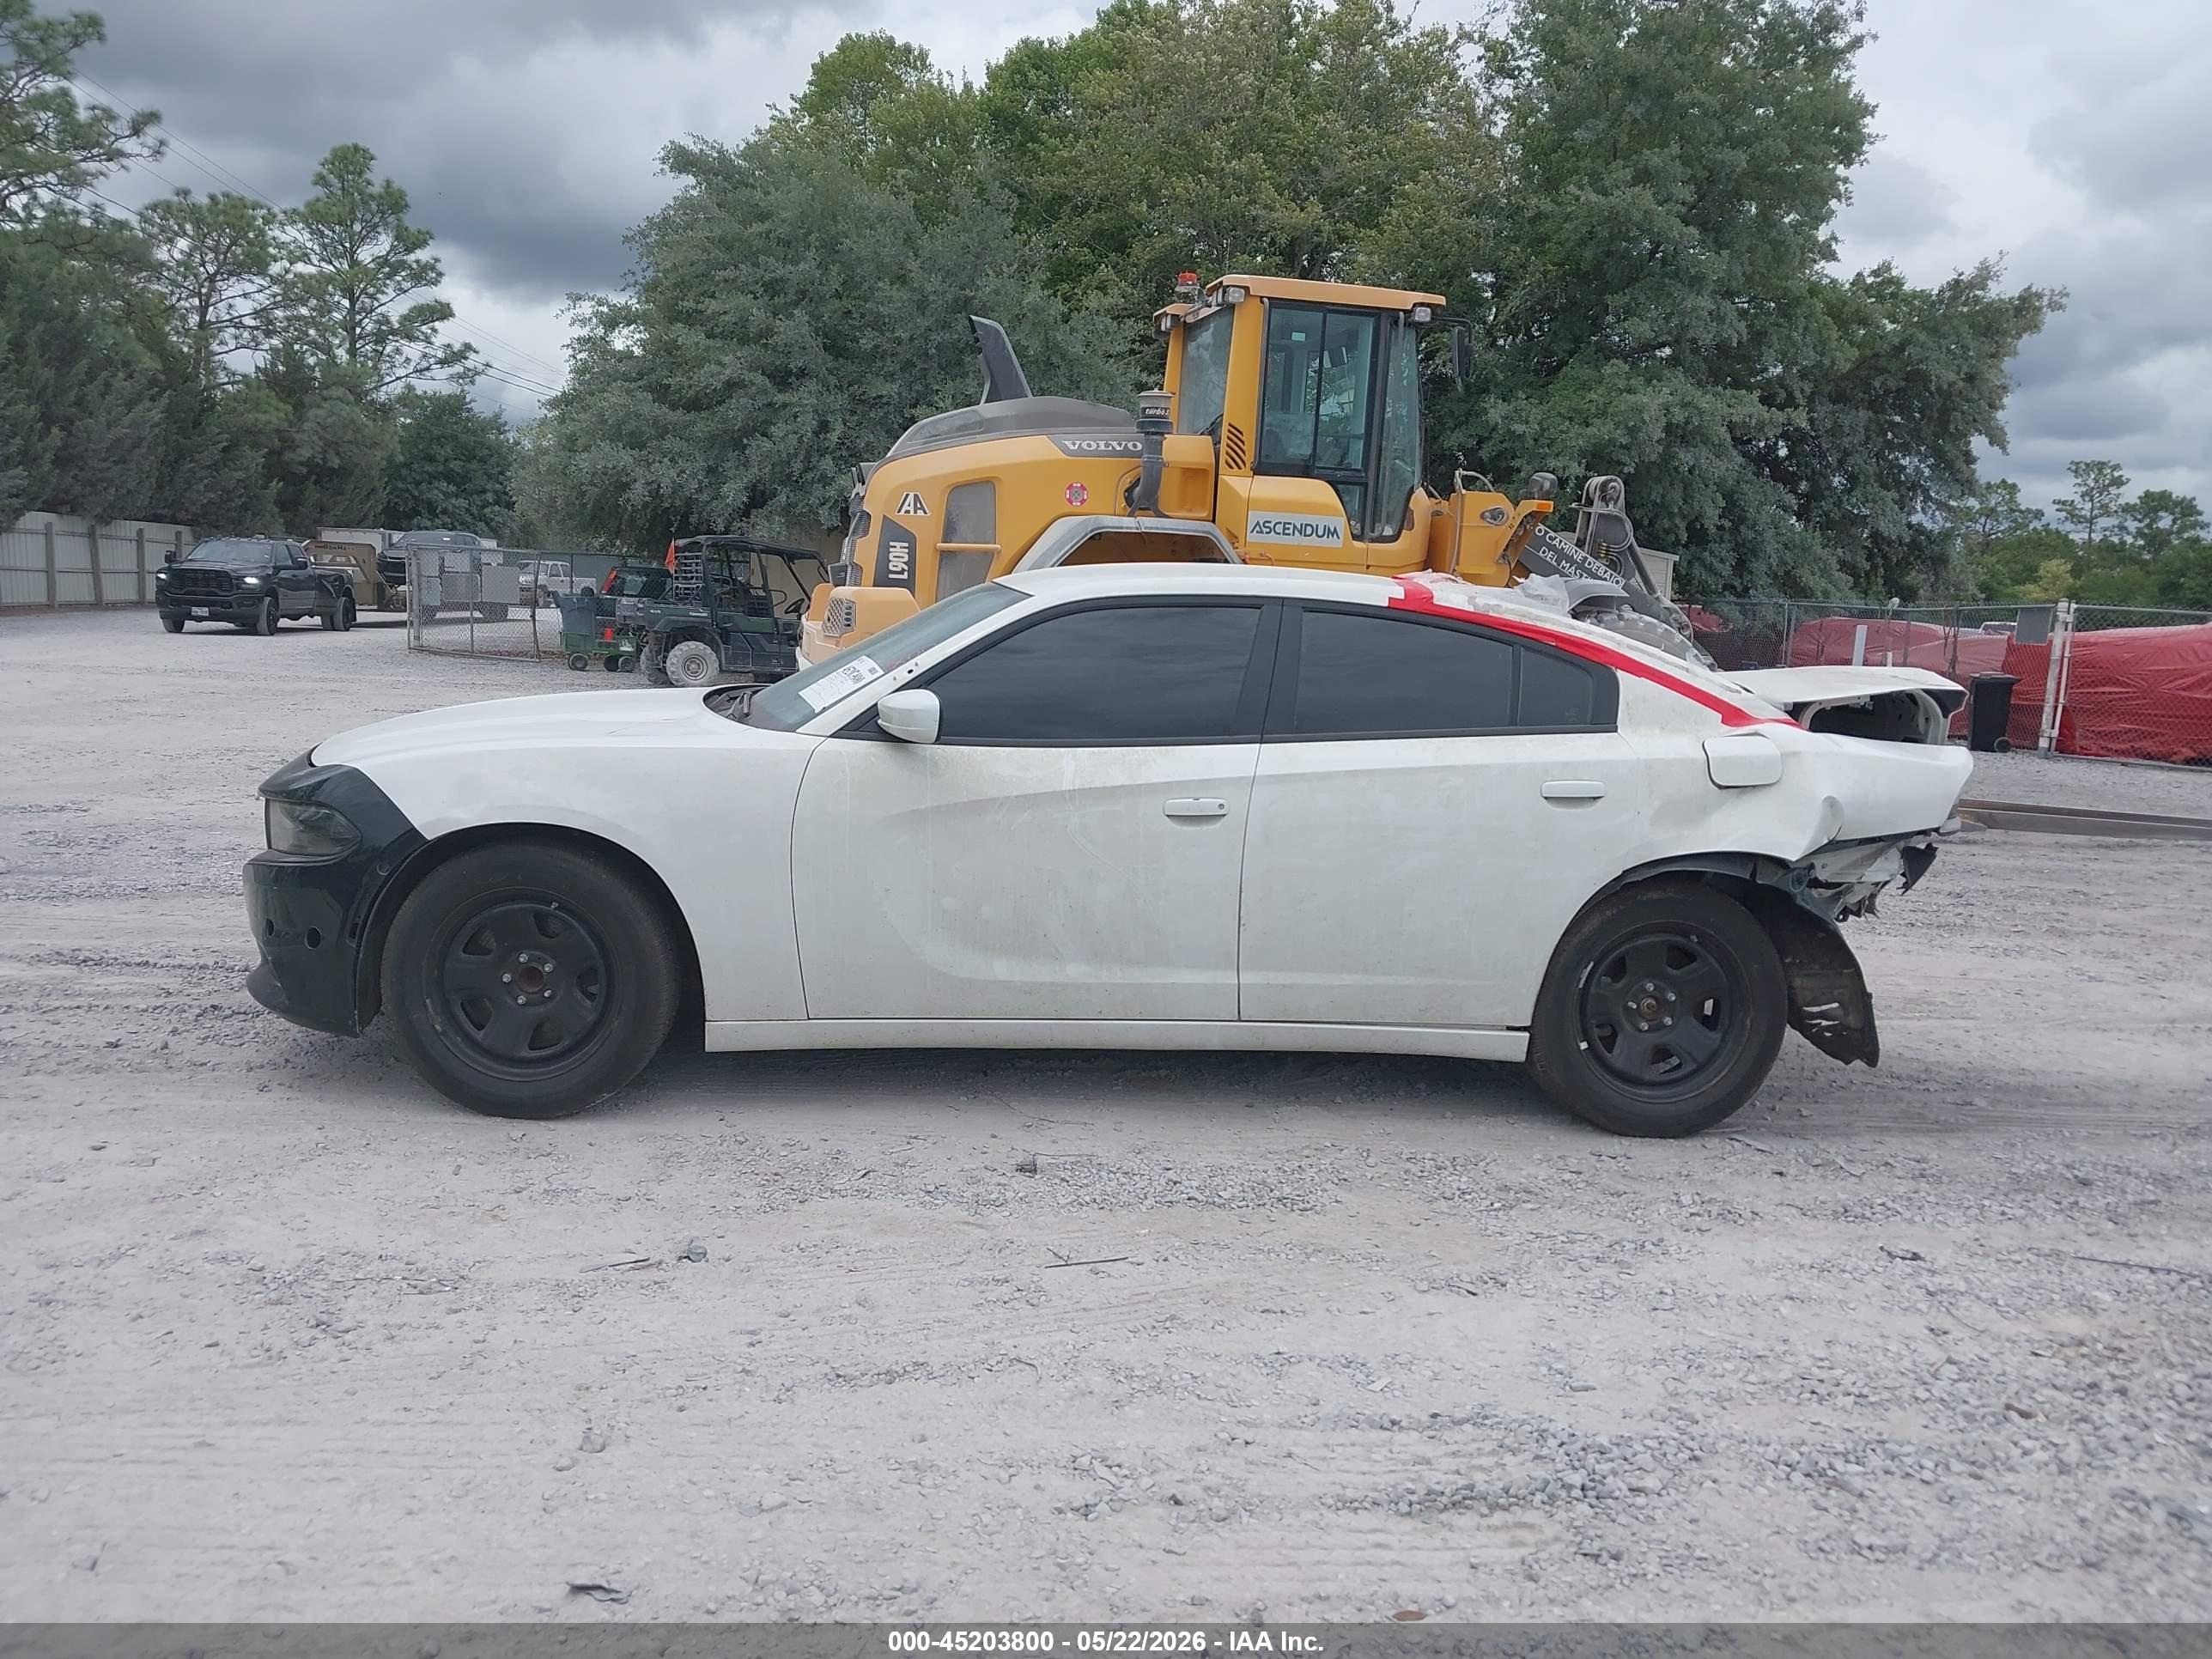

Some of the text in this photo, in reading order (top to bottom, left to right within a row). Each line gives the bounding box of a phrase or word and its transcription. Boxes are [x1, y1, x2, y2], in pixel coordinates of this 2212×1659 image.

[1061, 441, 1143, 451] VOLVO
[1250, 520, 1340, 540] ASCENDUM
[888, 541, 909, 580] L90H
[1546, 532, 1585, 563] CAMINE
[1539, 546, 1595, 581] DEL MÁST
